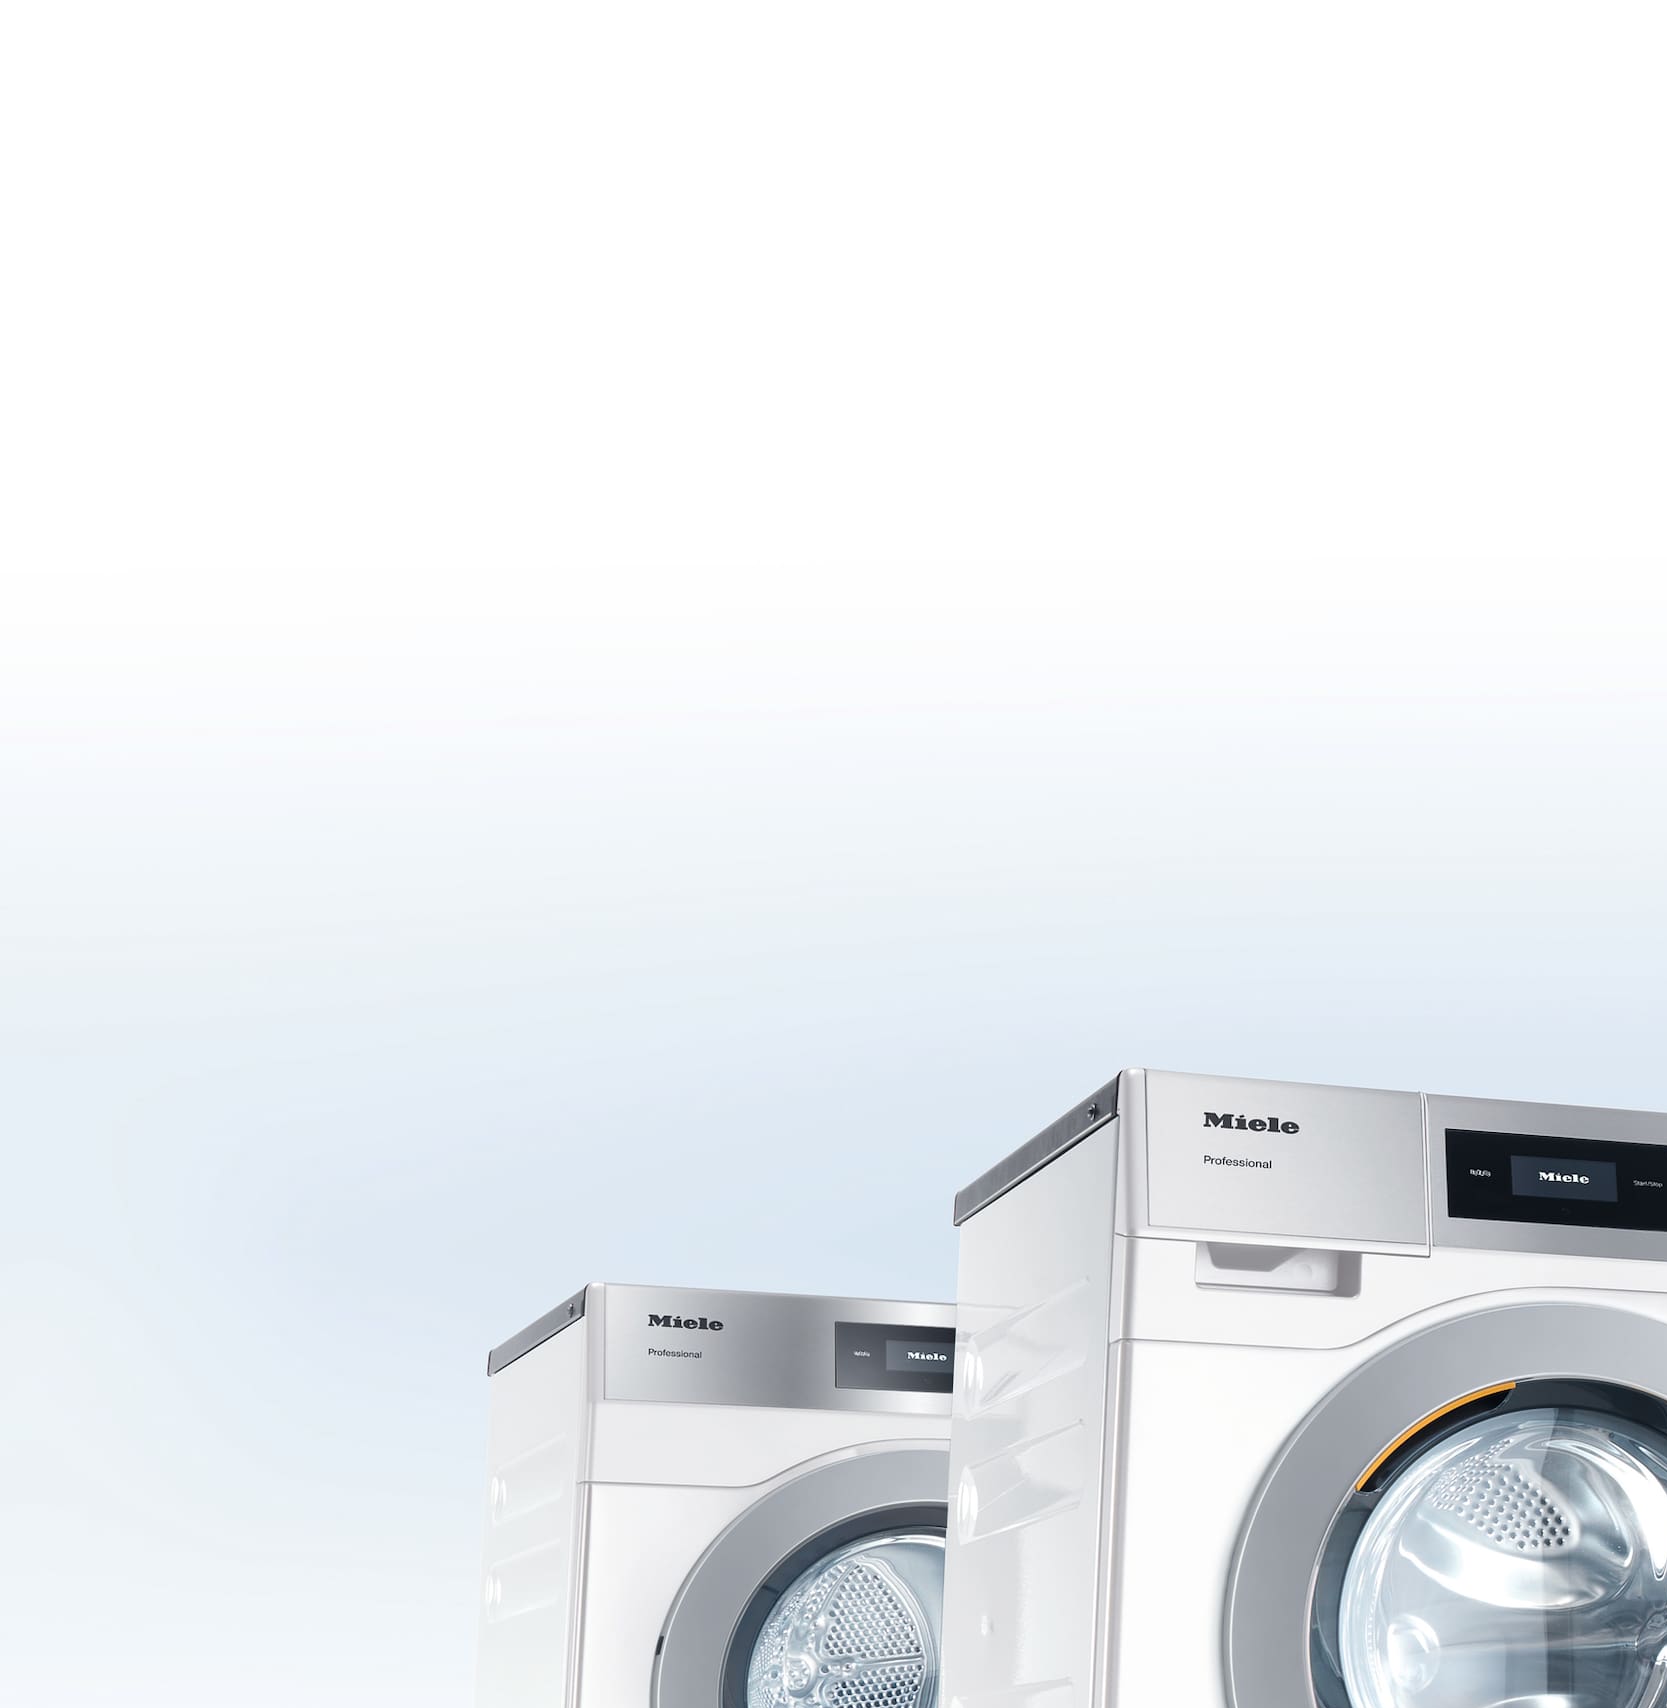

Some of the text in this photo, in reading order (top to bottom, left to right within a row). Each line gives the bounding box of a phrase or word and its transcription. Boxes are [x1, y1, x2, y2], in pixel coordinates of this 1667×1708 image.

[1203, 1112, 1300, 1134] Miele
[1203, 1155, 1272, 1169] Professional
[1539, 1171, 1590, 1185] Miele
[648, 1314, 724, 1331] Miele
[648, 1348, 702, 1359] Professional
[907, 1351, 947, 1361] Miele
